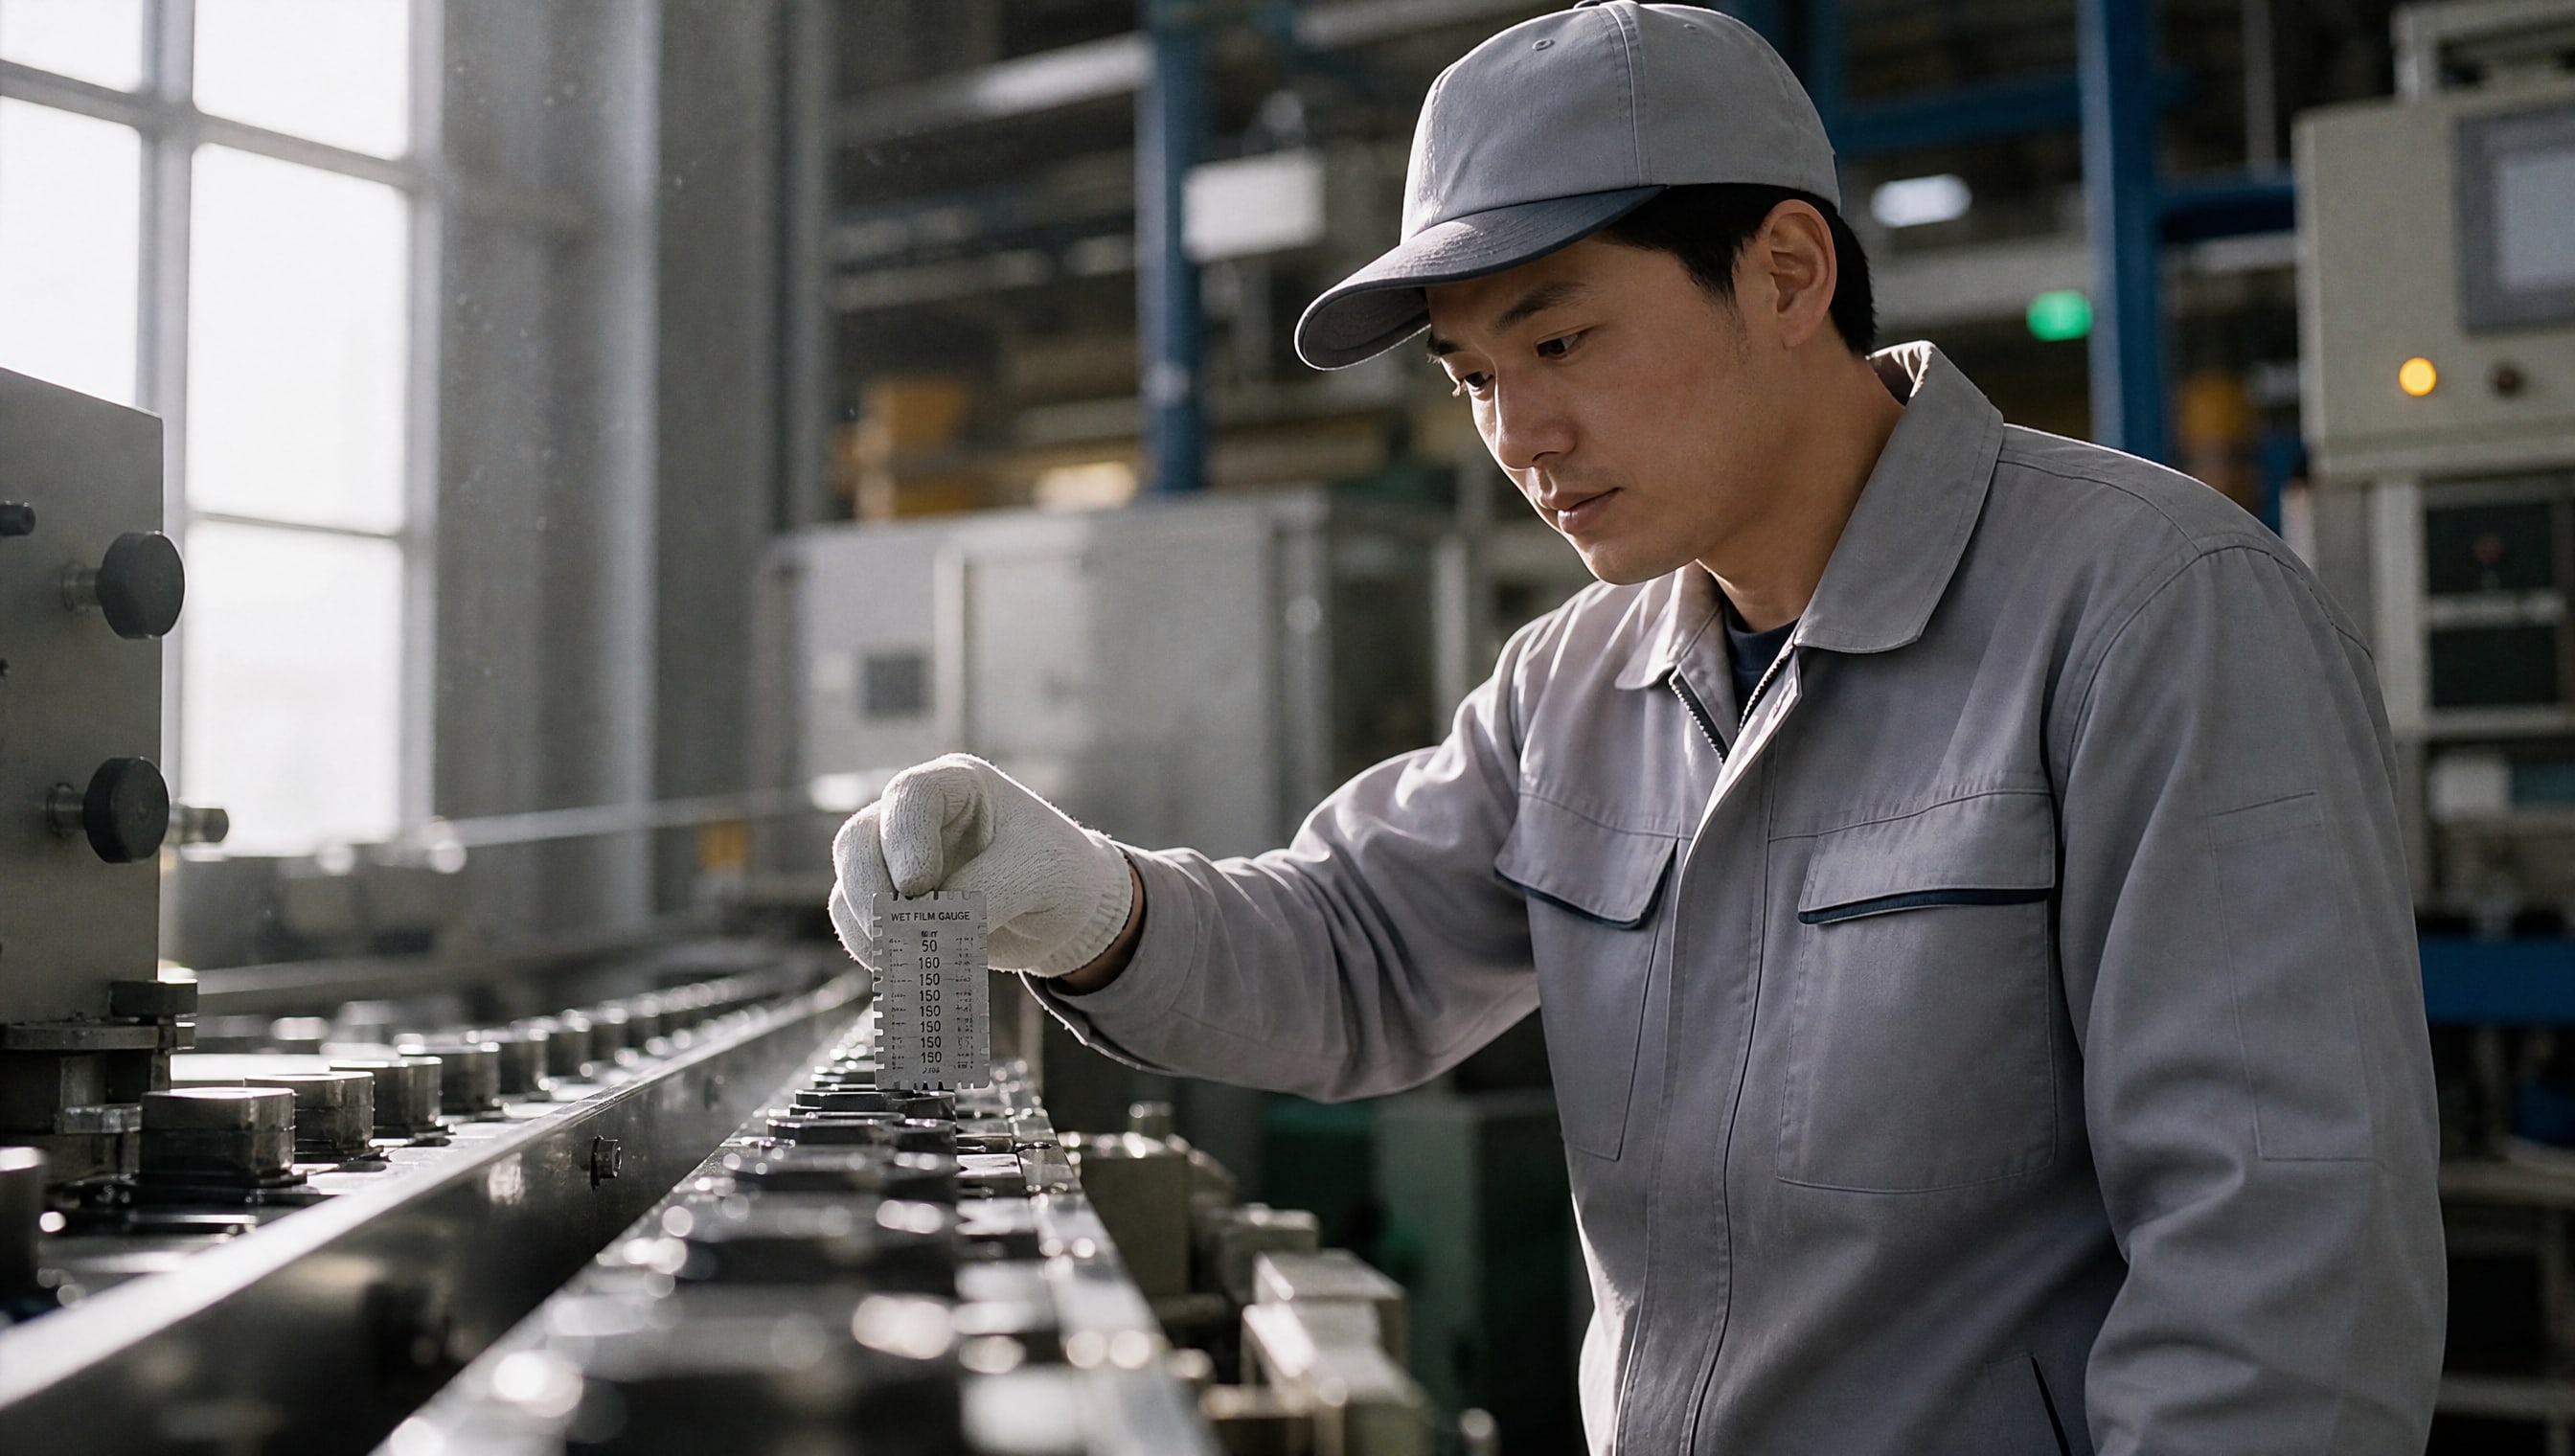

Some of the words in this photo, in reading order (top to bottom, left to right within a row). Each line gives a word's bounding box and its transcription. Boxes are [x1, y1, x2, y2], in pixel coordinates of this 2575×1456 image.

[890, 912, 911, 921] WET
[913, 912, 936, 921] FILM
[938, 911, 970, 921] GAUGE
[921, 940, 938, 952] 50
[920, 973, 940, 986] 150
[920, 990, 941, 1002] 150
[920, 1005, 941, 1017] 150
[921, 1020, 942, 1033] 150
[921, 1036, 942, 1049] 150
[921, 1051, 942, 1063] 150
